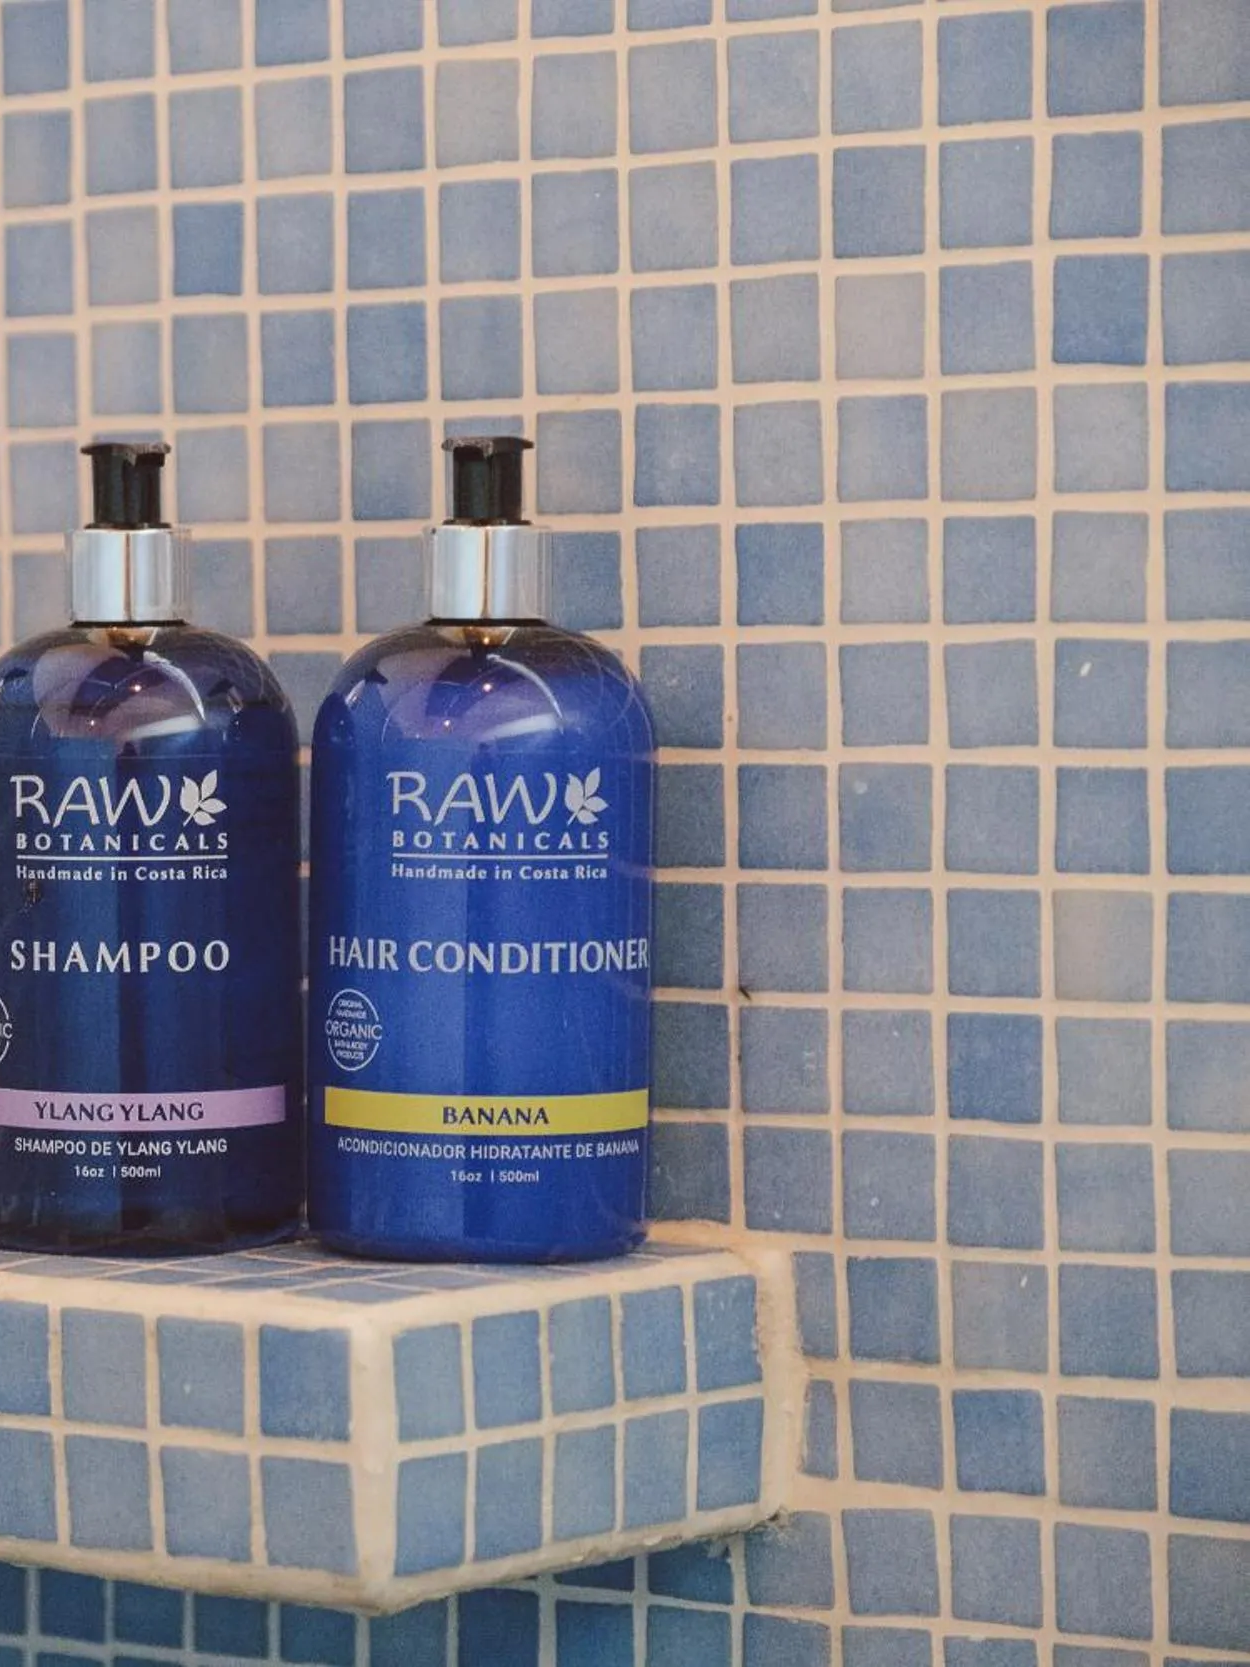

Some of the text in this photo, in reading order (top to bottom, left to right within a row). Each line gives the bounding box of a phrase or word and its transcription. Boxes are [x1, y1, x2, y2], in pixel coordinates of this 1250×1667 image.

[9, 774, 171, 828] RAW
[386, 771, 557, 826] RAW
[16, 833, 228, 851] BOTANICALS
[392, 830, 609, 850] BOTANICALS
[16, 865, 227, 881] Handmade in Costa Rica
[392, 864, 607, 880] Handmade in Costa Rica
[10, 939, 230, 973] SHAMPOO
[329, 935, 650, 974] HAIR CONDITIONER
[325, 1019, 382, 1040] ORGANIC
[34, 1100, 204, 1122] YLANG YLANG
[442, 1106, 550, 1126] BANANA
[14, 1136, 227, 1157] SHAMPOO DE YLANG YLANG
[338, 1136, 639, 1160] ACONDICIONADOR HIDRATANTE DE BANANA
[74, 1165, 104, 1178] 16oz
[121, 1165, 161, 1178] 500ml
[450, 1169, 482, 1182] 16oz
[499, 1169, 539, 1183] 500ml
